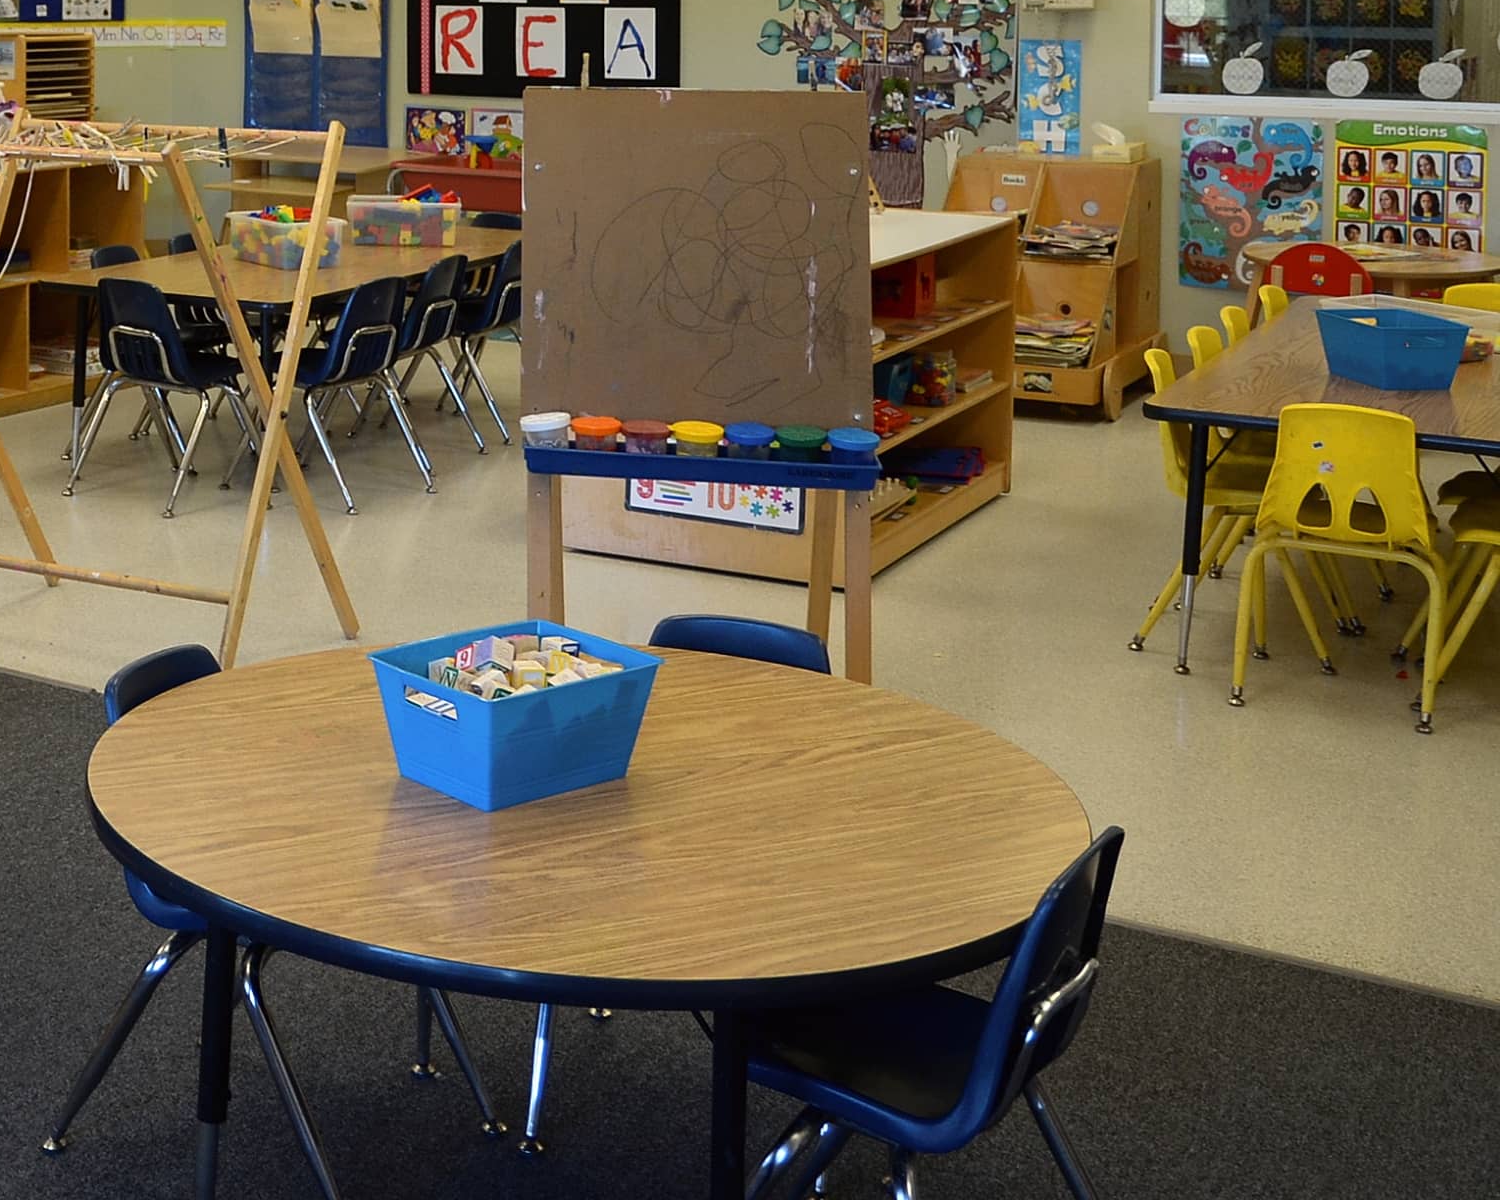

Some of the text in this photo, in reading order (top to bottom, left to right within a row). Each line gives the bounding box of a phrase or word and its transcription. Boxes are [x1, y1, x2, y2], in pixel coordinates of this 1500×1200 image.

[93, 28, 116, 41] Mm
[121, 27, 139, 40] Nn
[143, 27, 162, 40] Oo
[185, 27, 204, 47] Qq
[209, 27, 224, 40] Rr
[440, 8, 477, 72] R
[522, 15, 557, 78] E
[607, 18, 652, 78] A
[1184, 119, 1251, 138] Colors
[1373, 123, 1448, 138] Emotions
[1214, 206, 1243, 214] orange
[1281, 214, 1307, 222] yellow
[637, 479, 654, 499] 9
